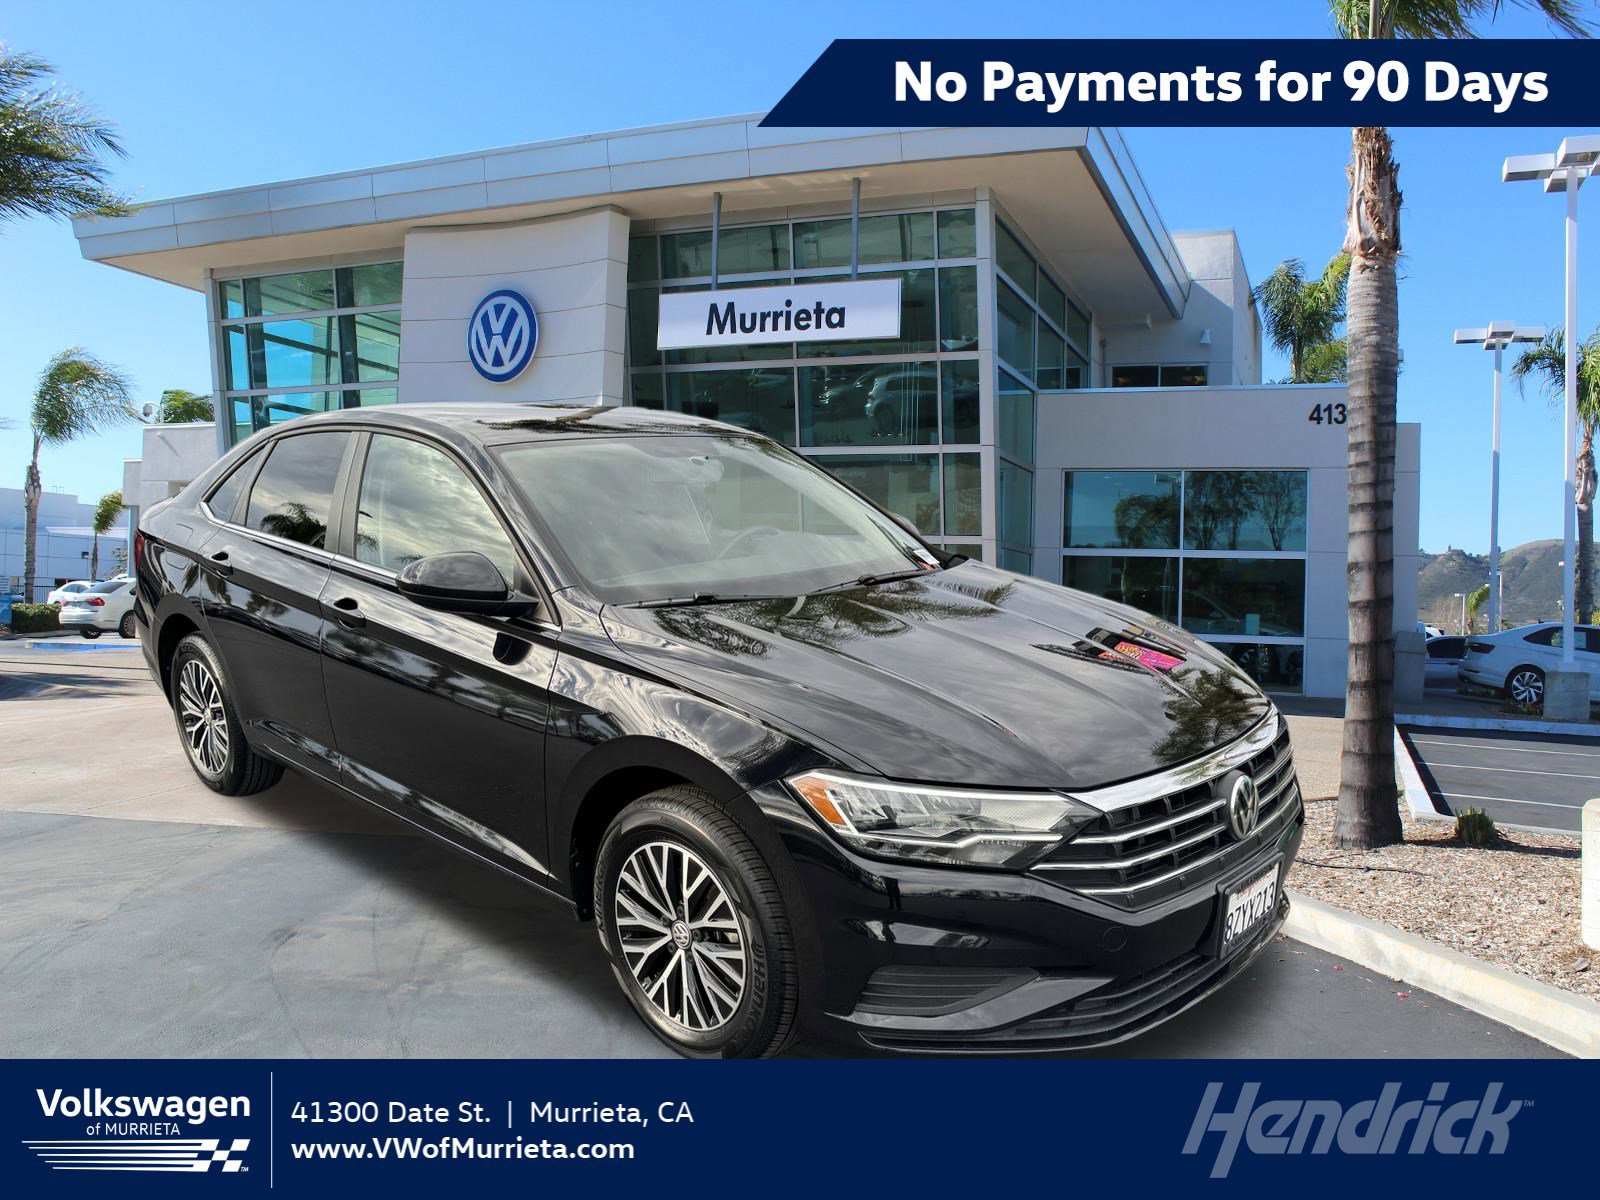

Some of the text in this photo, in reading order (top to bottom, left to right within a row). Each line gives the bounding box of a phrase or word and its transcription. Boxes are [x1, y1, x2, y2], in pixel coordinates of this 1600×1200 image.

[473, 294, 533, 377] VW
[705, 299, 847, 337] Murrieta
[1308, 403, 1348, 425] 413
[1224, 881, 1275, 943] 8ZYX213
